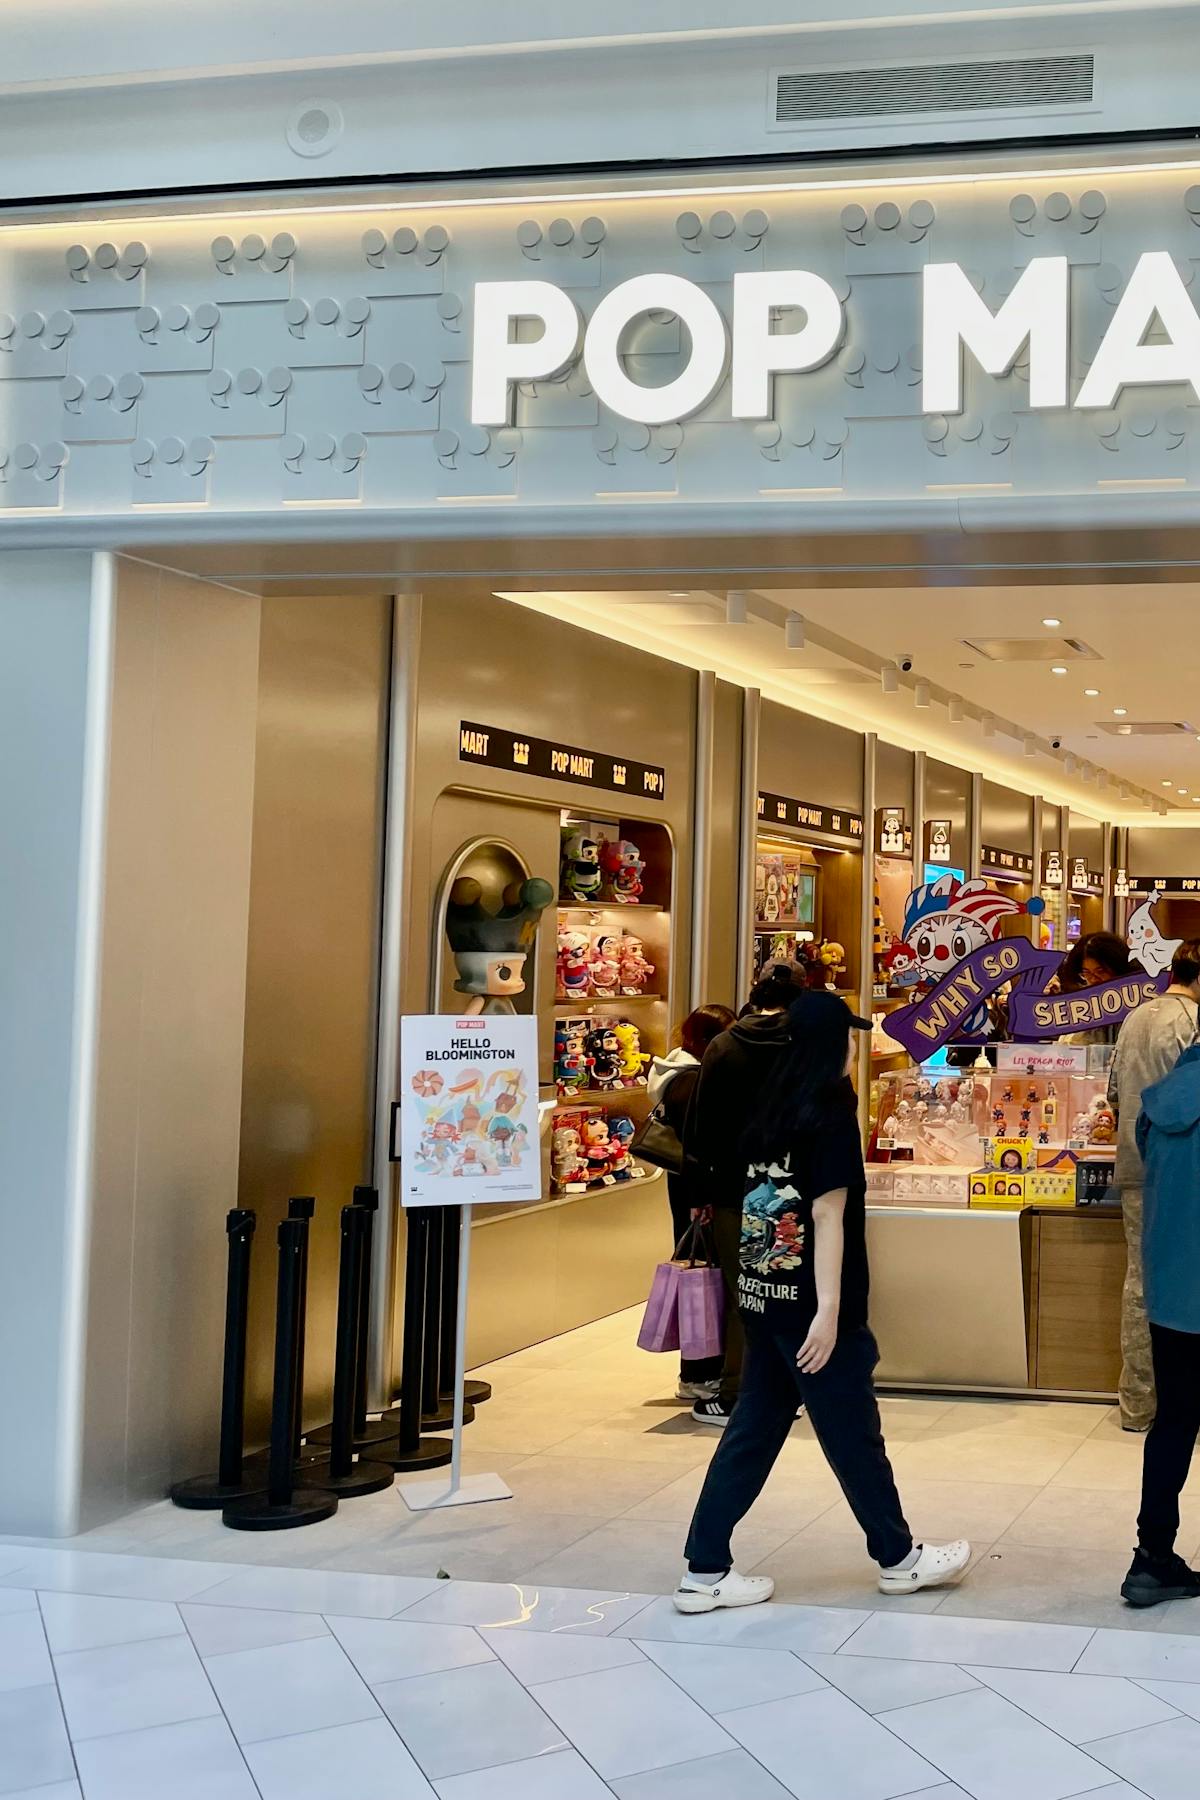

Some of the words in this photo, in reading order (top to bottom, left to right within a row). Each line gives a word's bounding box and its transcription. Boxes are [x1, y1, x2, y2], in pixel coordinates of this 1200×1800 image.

[471, 269, 846, 426] POP
[460, 729, 489, 757] MART
[551, 749, 570, 773] POP
[569, 753, 595, 779] MART
[643, 771, 659, 792] POP
[797, 806, 808, 824] POP
[1182, 879, 1196, 890] POP
[914, 965, 983, 1039] WHY
[983, 947, 1020, 979] SO
[1034, 983, 1160, 1027] SERIOUS
[425, 1049, 515, 1061] BLOOMINGTON
[451, 1038, 491, 1049] HELLO
